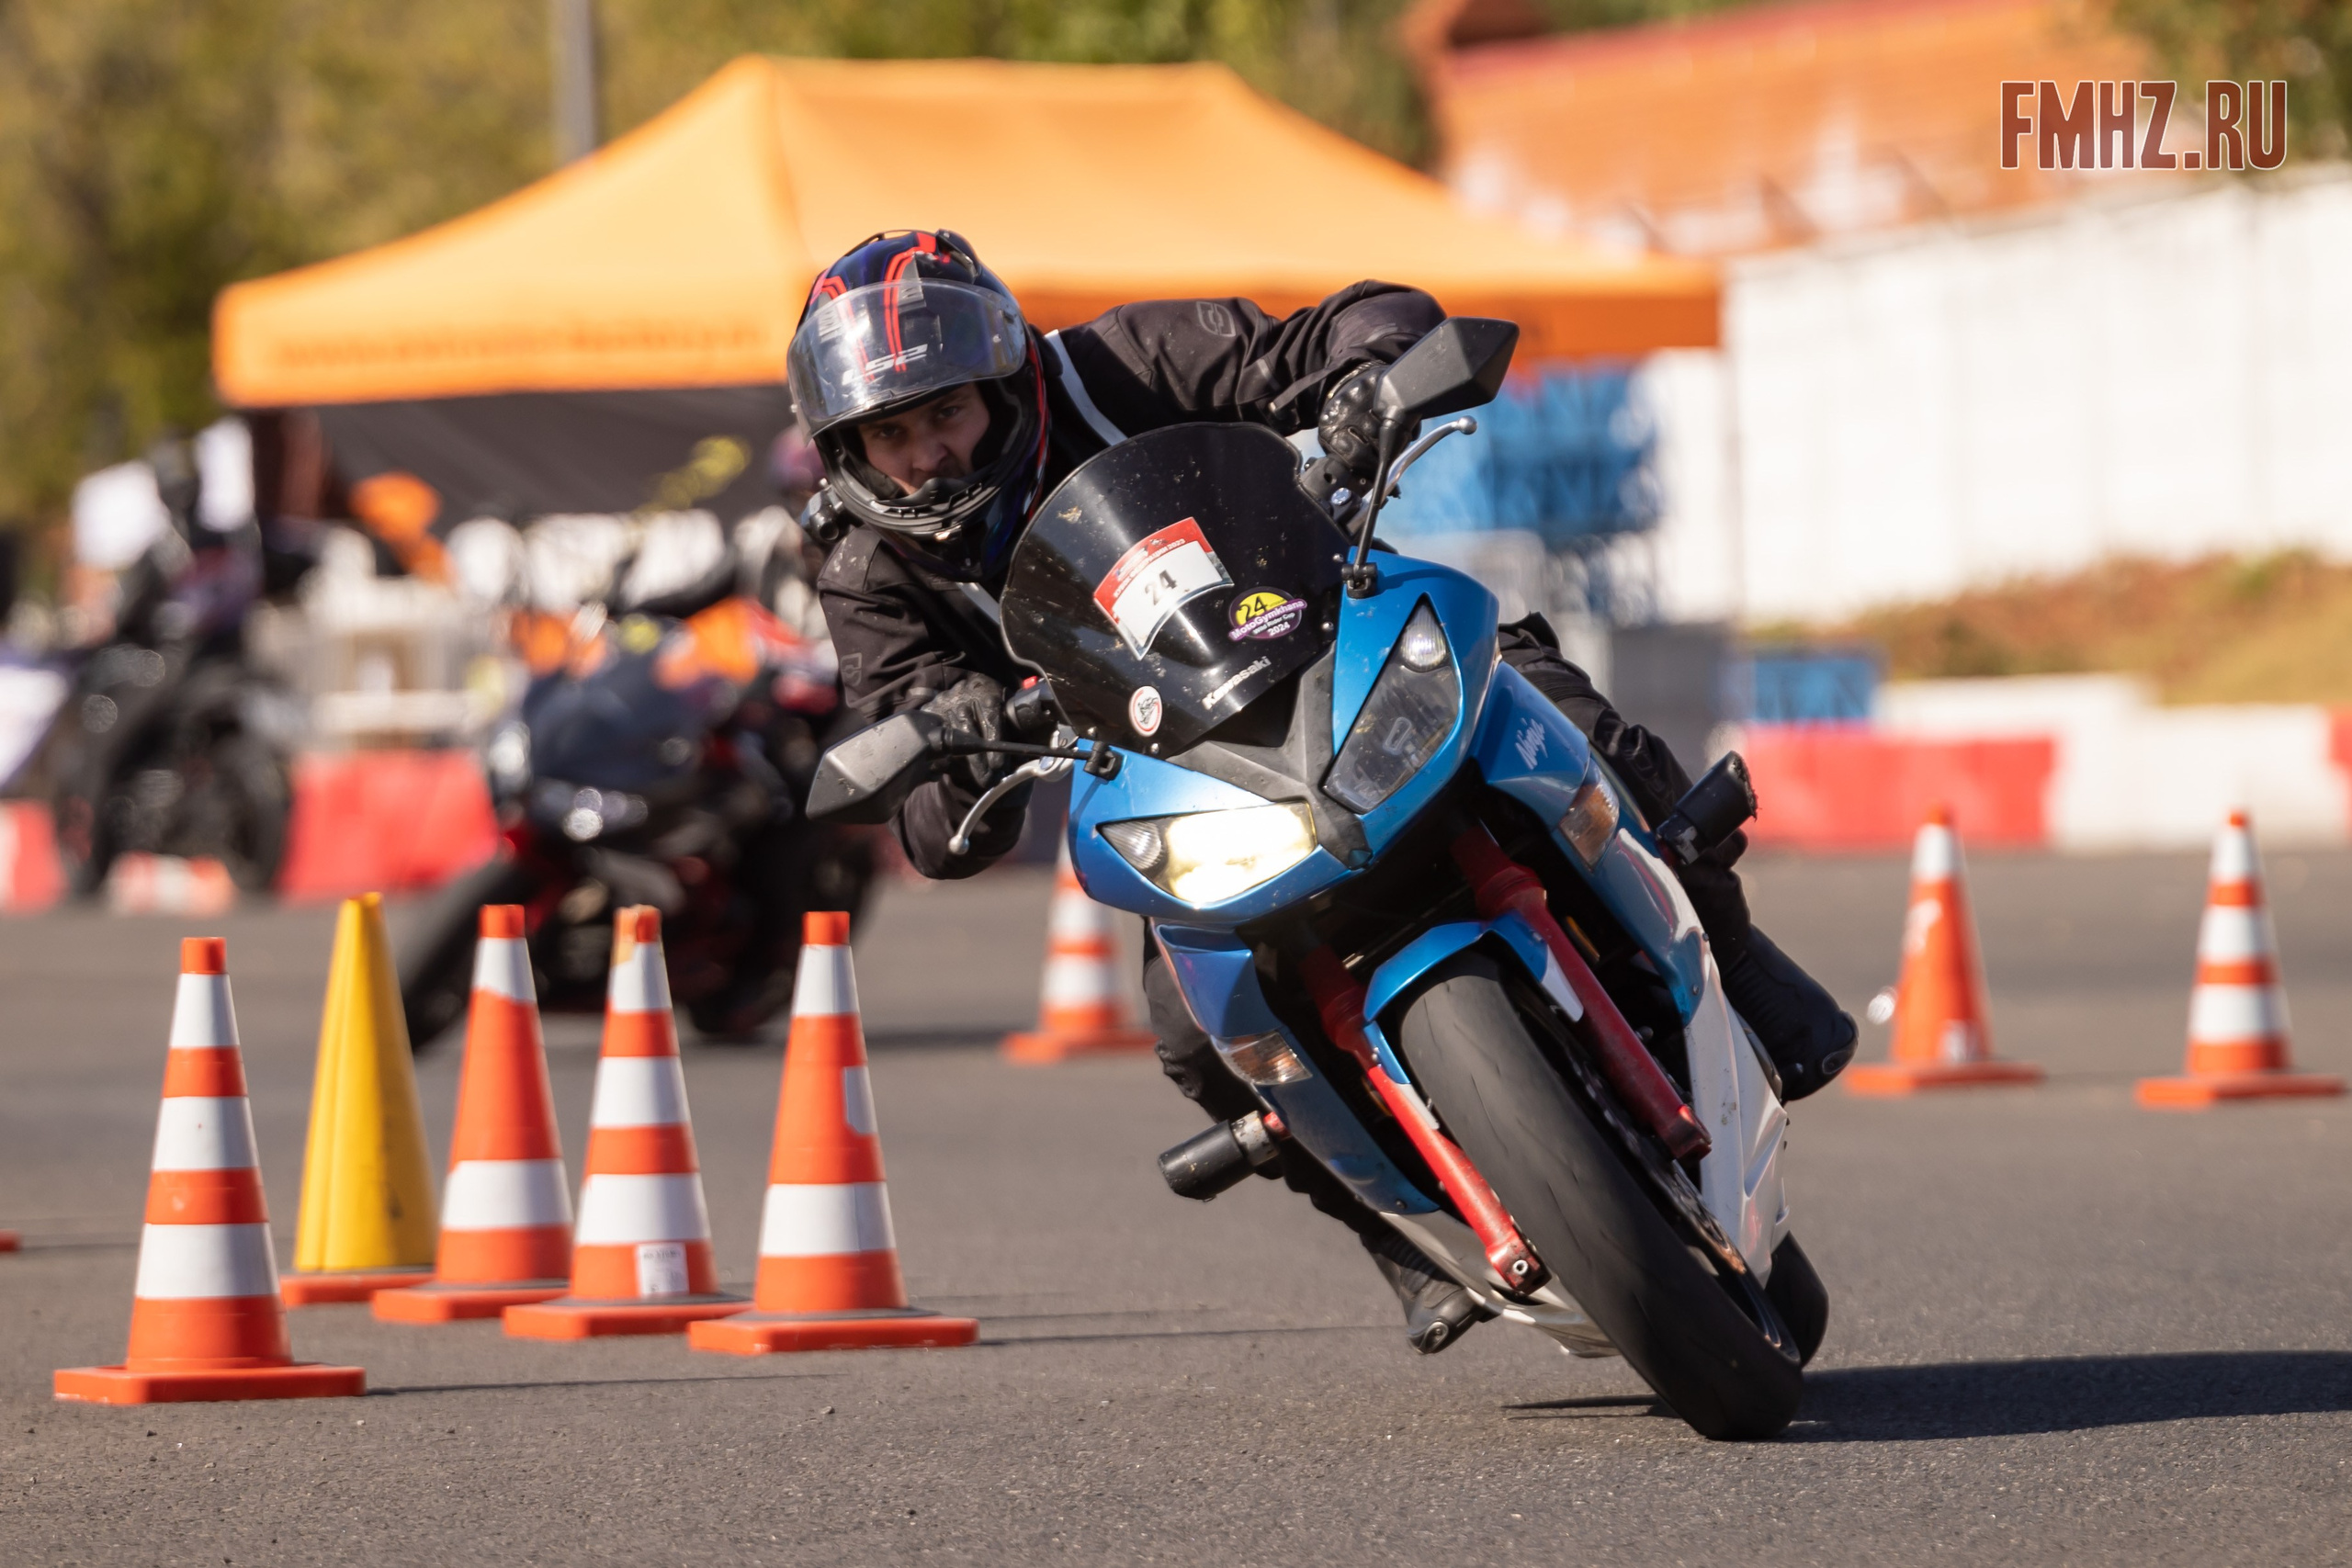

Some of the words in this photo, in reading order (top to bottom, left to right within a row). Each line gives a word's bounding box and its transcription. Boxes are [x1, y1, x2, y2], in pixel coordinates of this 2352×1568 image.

[842, 344, 928, 386] LS2
[1145, 570, 1177, 606] 24
[1231, 601, 1305, 639] MotoGymkhana
[1238, 595, 1267, 622] 24
[1268, 621, 1291, 637] 2024
[1202, 656, 1272, 710] Kawasaki
